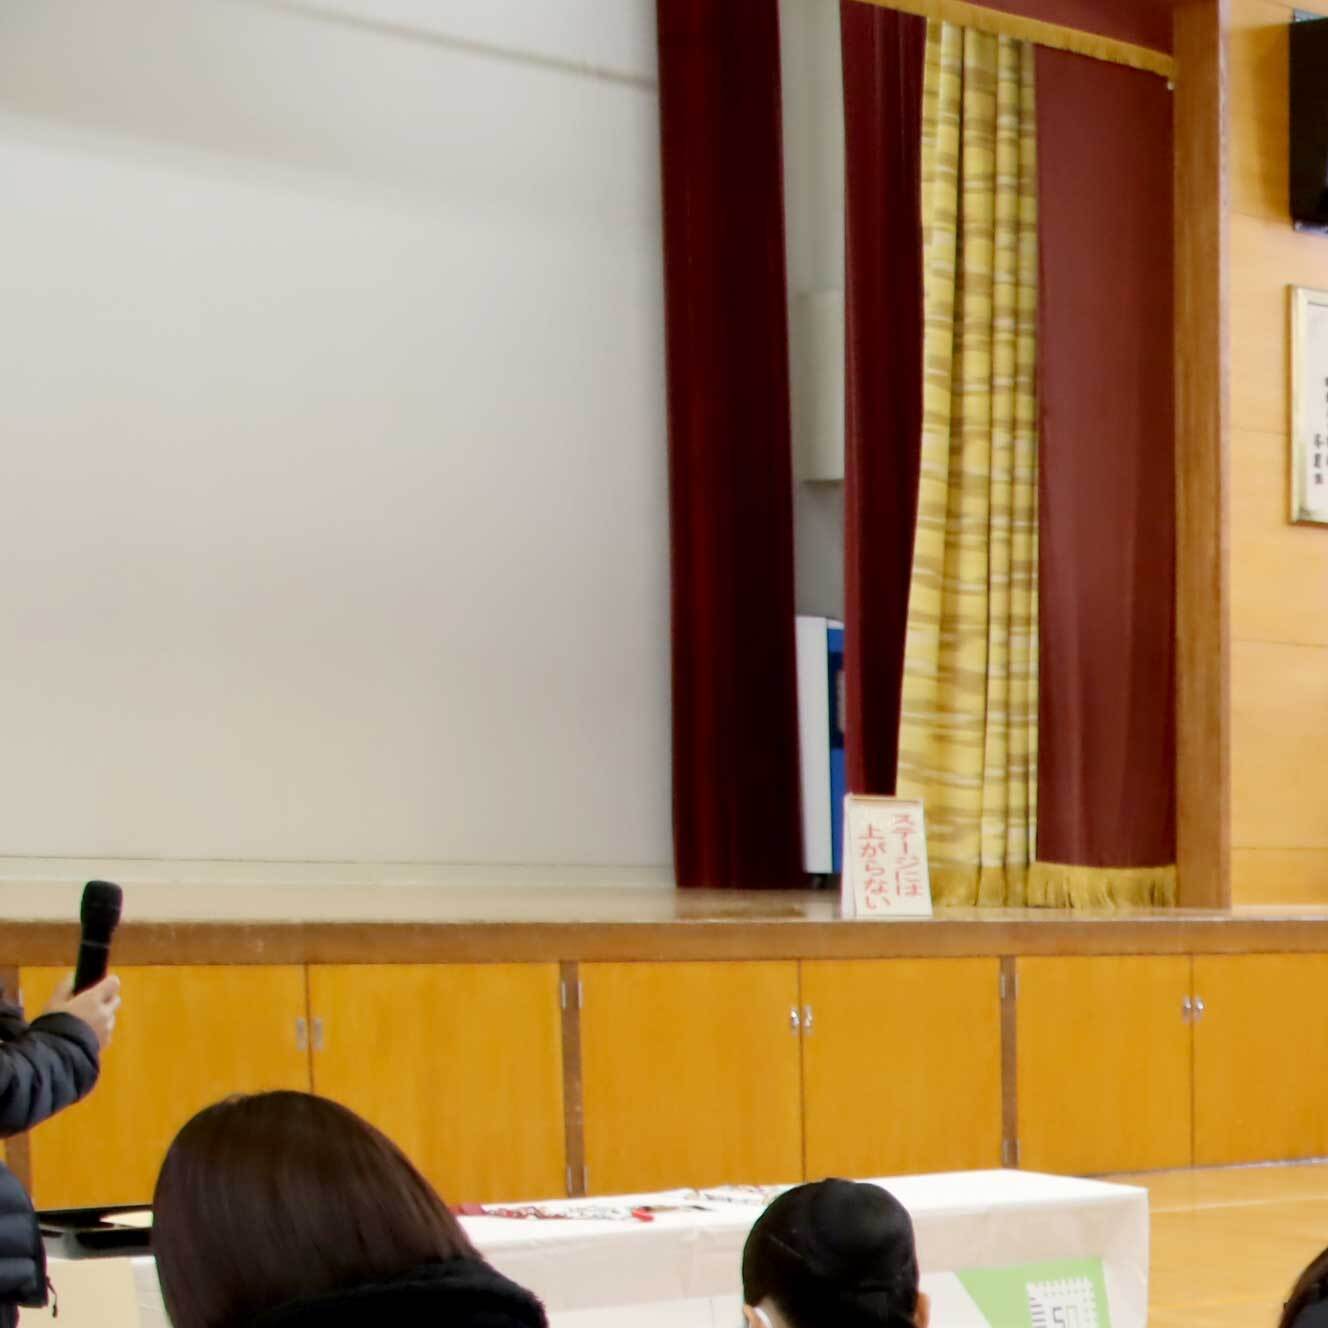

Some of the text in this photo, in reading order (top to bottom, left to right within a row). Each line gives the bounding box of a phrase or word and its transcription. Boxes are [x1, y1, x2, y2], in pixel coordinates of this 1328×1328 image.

[857, 823, 891, 910] 上がらない
